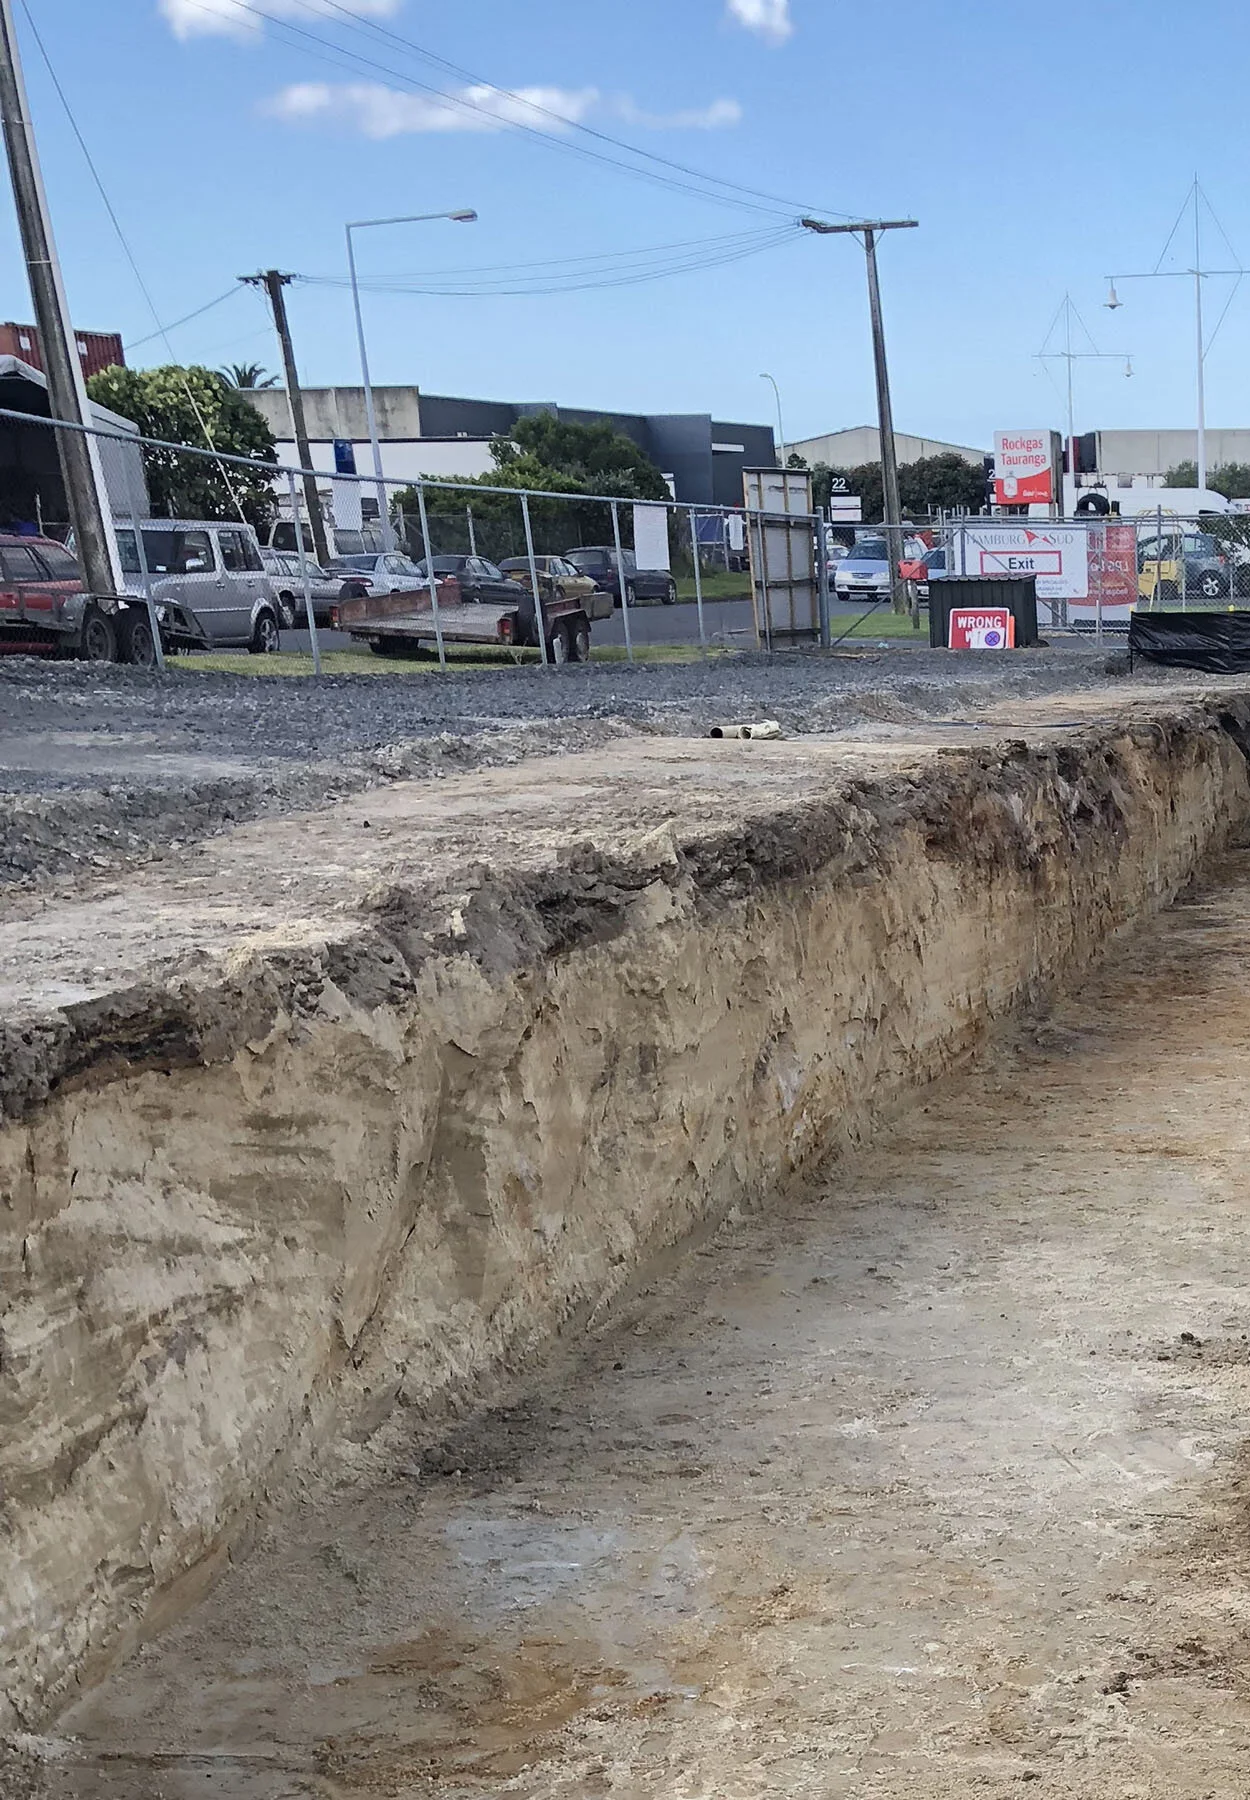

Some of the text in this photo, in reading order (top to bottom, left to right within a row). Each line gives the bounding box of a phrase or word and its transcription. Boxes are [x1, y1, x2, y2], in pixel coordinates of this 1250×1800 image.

[1002, 436, 1043, 452] Rockgas
[1000, 453, 1046, 467] Tauranga
[832, 478, 846, 489] 22
[966, 534, 1026, 545] HAMBURG
[1008, 557, 1035, 570] Exit
[957, 616, 1002, 628] WRONG
